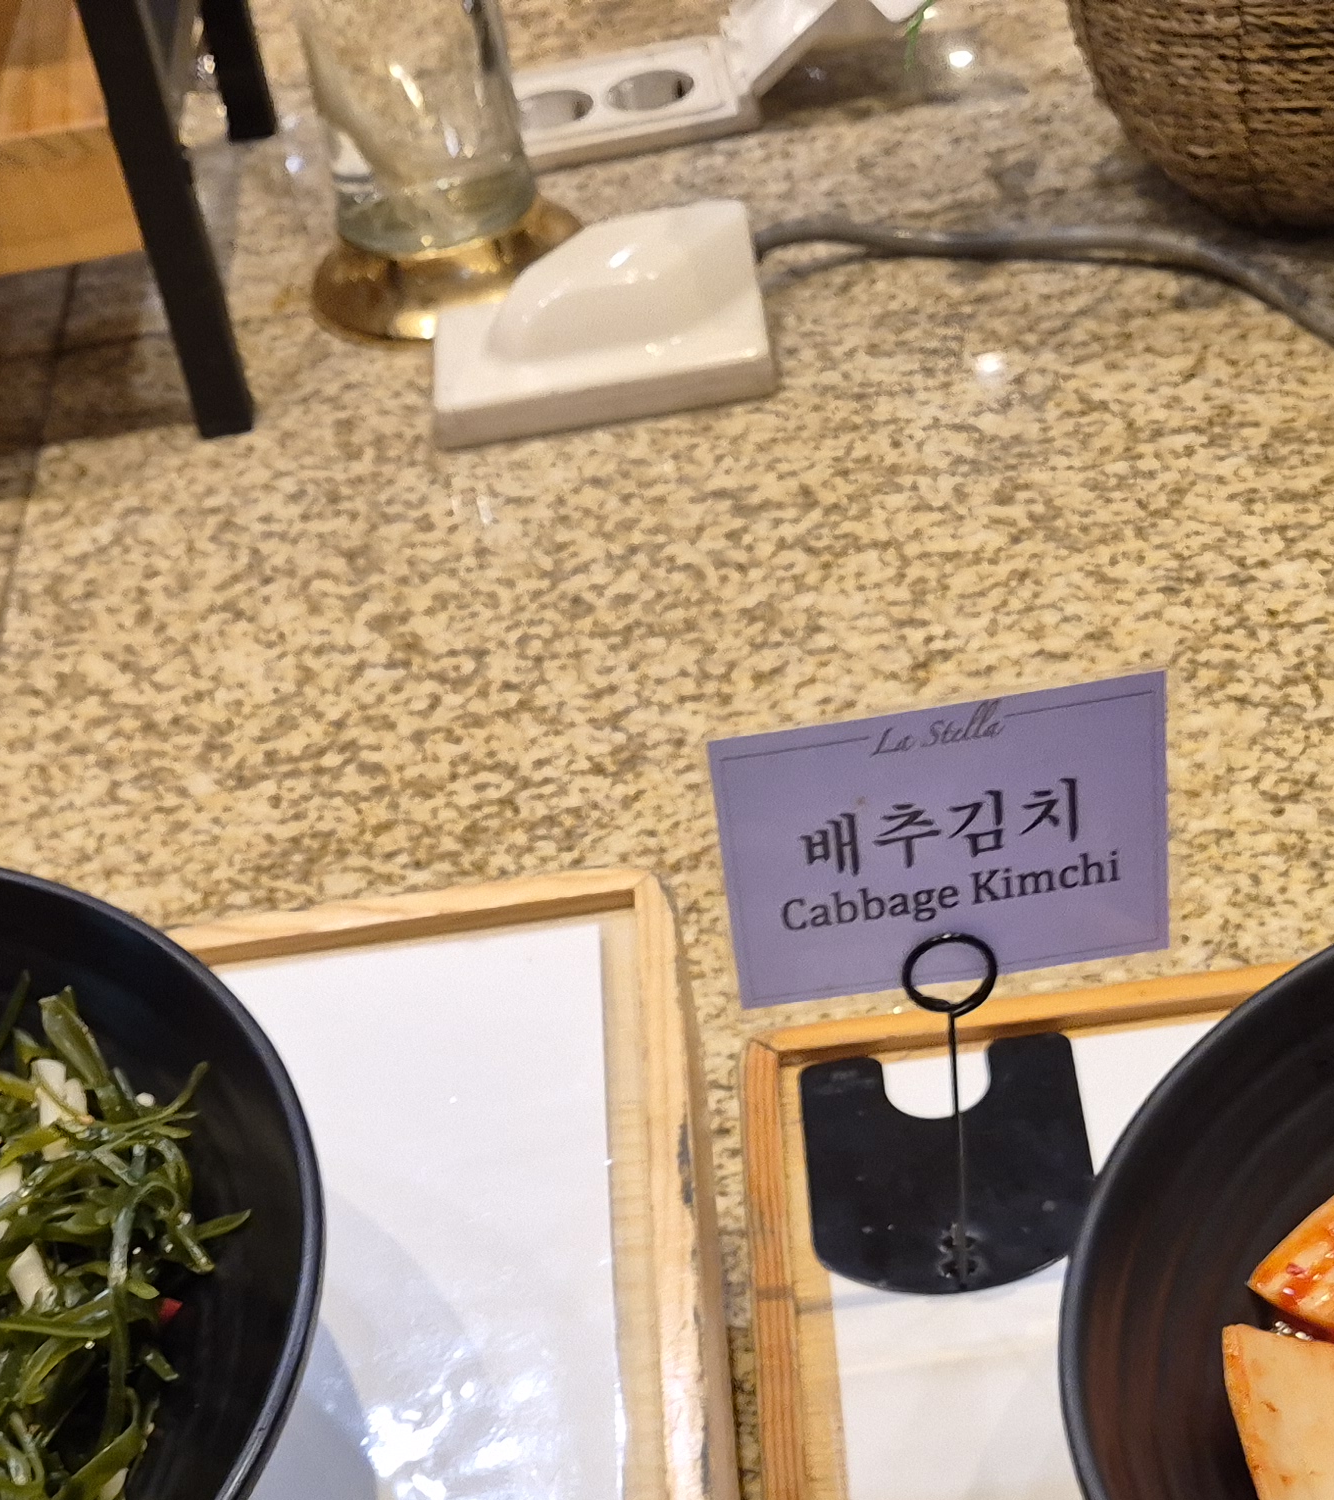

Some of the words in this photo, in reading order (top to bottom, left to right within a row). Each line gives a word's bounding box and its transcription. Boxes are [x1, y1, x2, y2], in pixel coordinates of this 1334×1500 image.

[870, 728, 913, 758] La
[920, 699, 1006, 749] Stella
[799, 777, 1080, 877] 배추김치
[780, 883, 959, 932] Cabbage
[971, 849, 1122, 905] Kimchi
